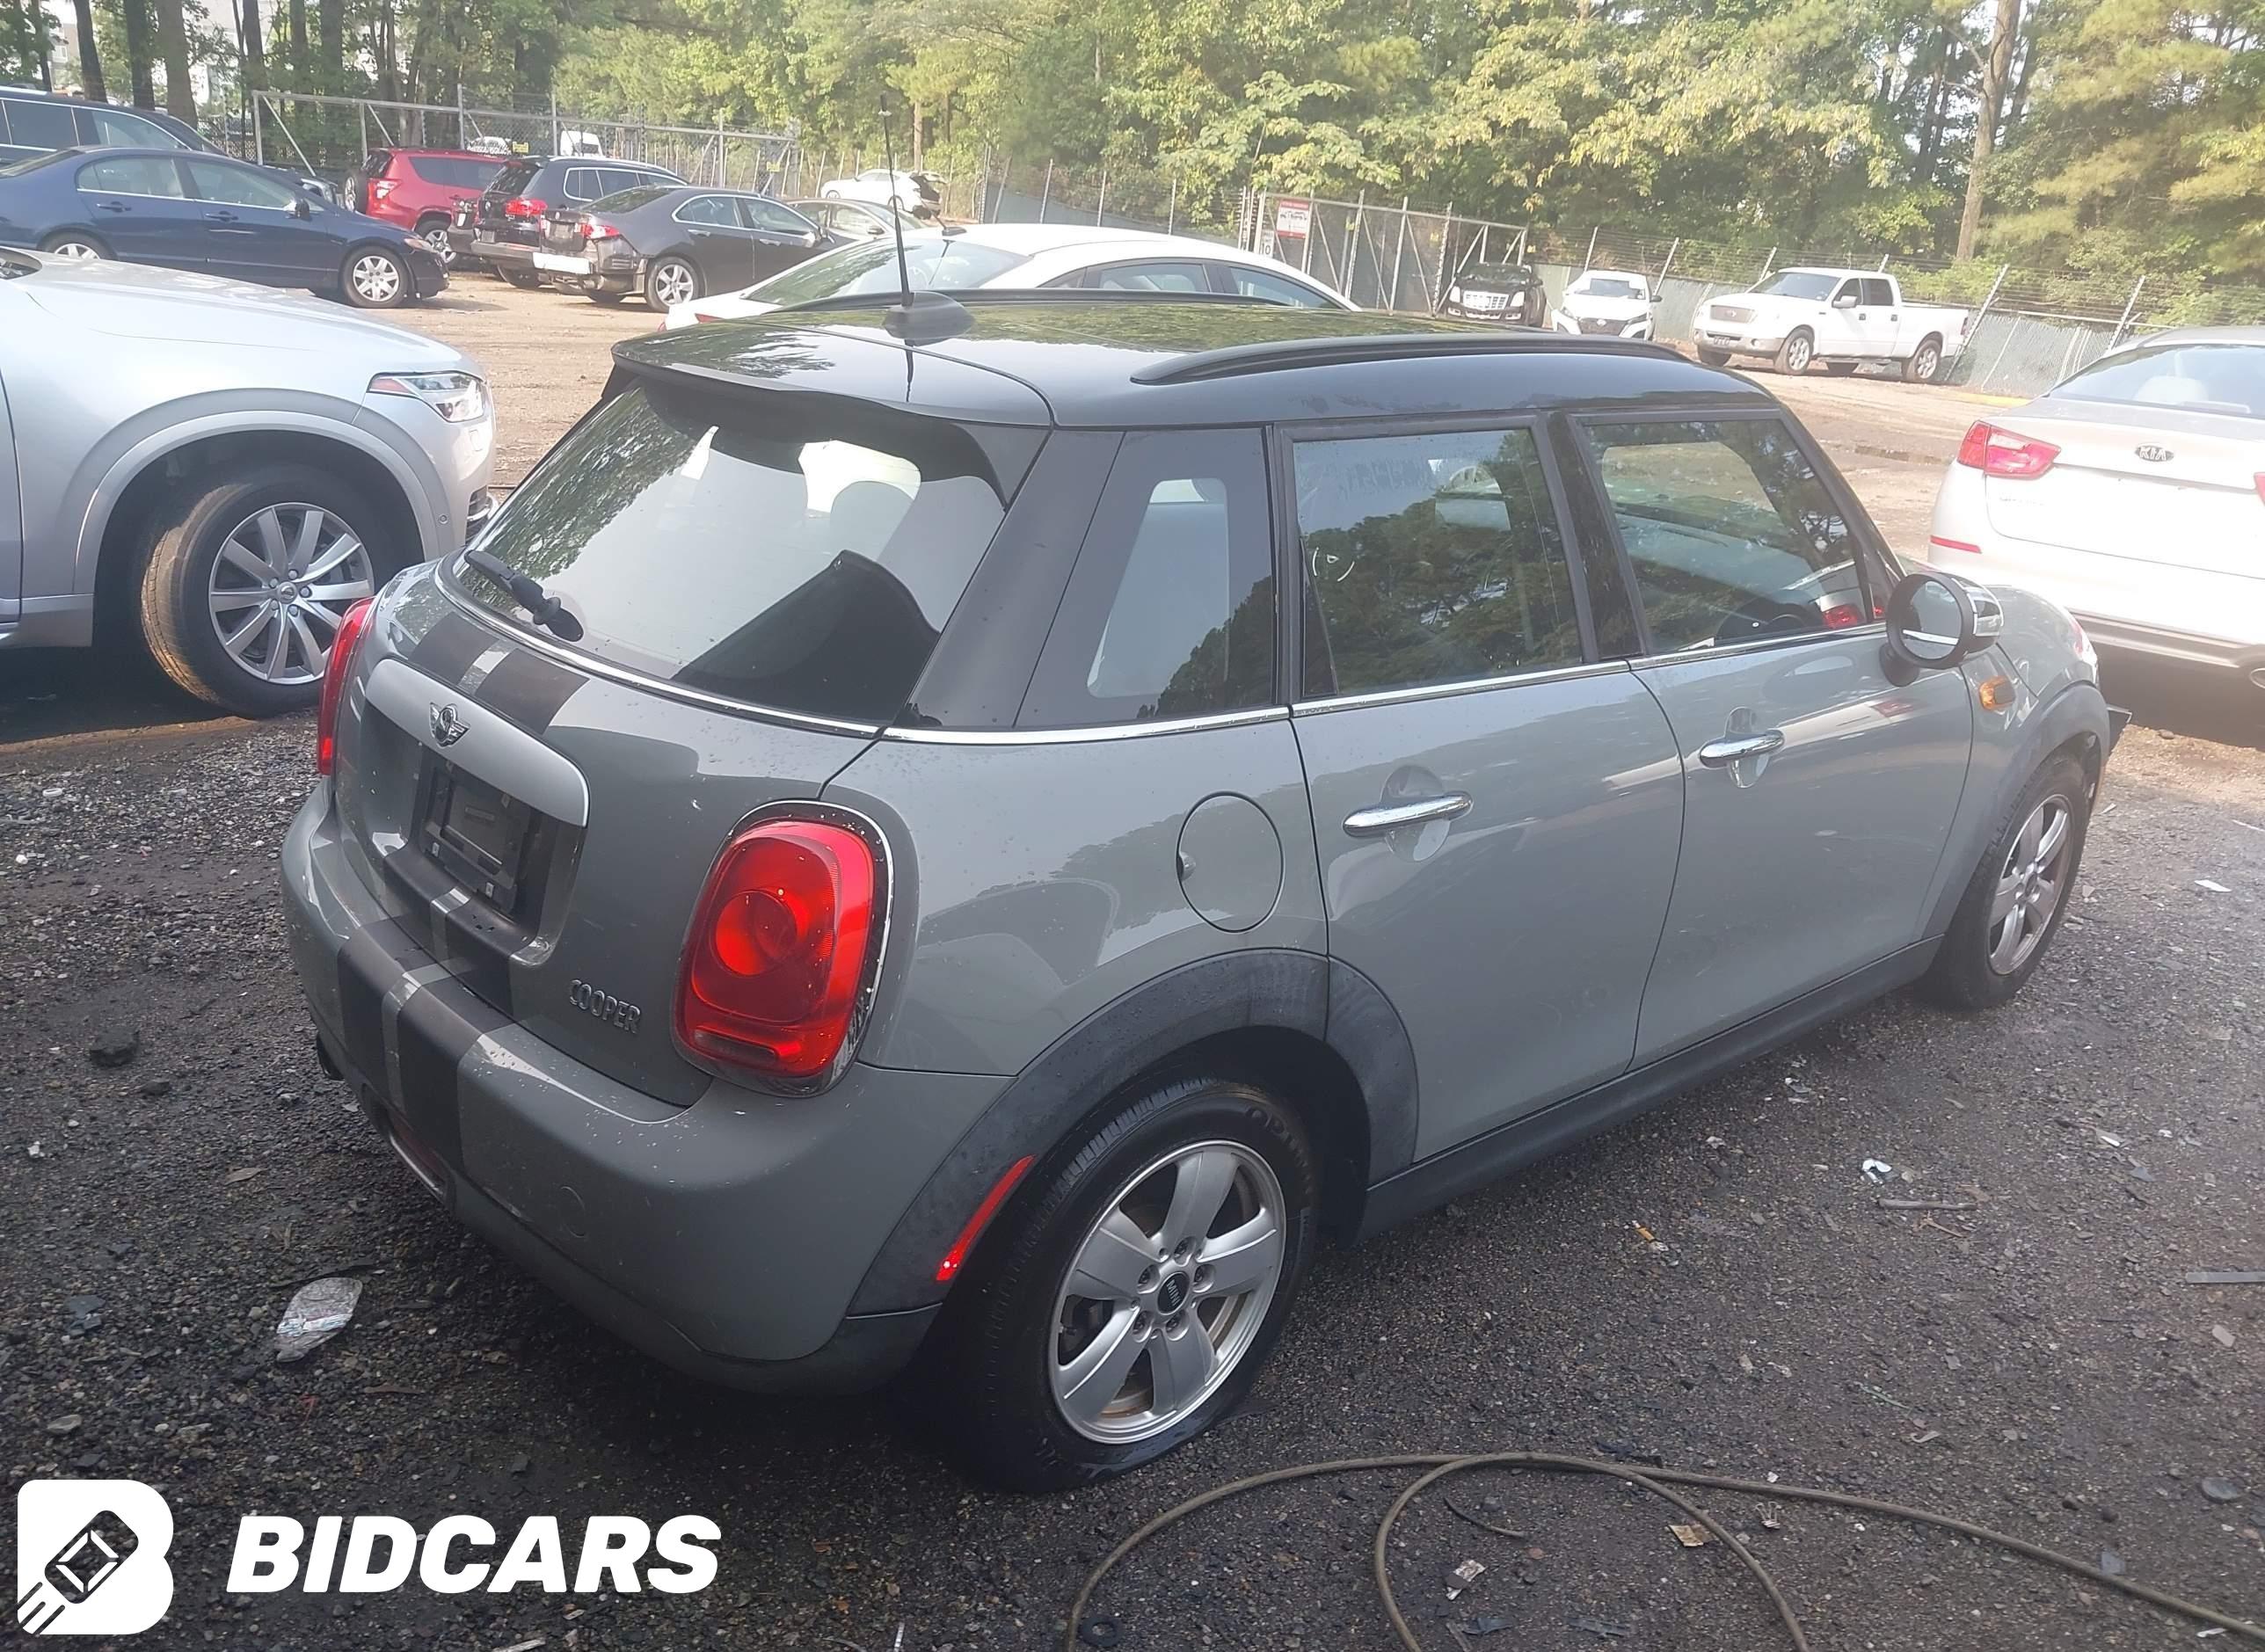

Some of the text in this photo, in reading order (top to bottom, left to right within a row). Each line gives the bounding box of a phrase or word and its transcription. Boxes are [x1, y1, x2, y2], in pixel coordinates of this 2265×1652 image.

[2138, 446, 2167, 461] KIA
[569, 979, 641, 1034] COOPER
[1166, 1278, 1181, 1306] MINI
